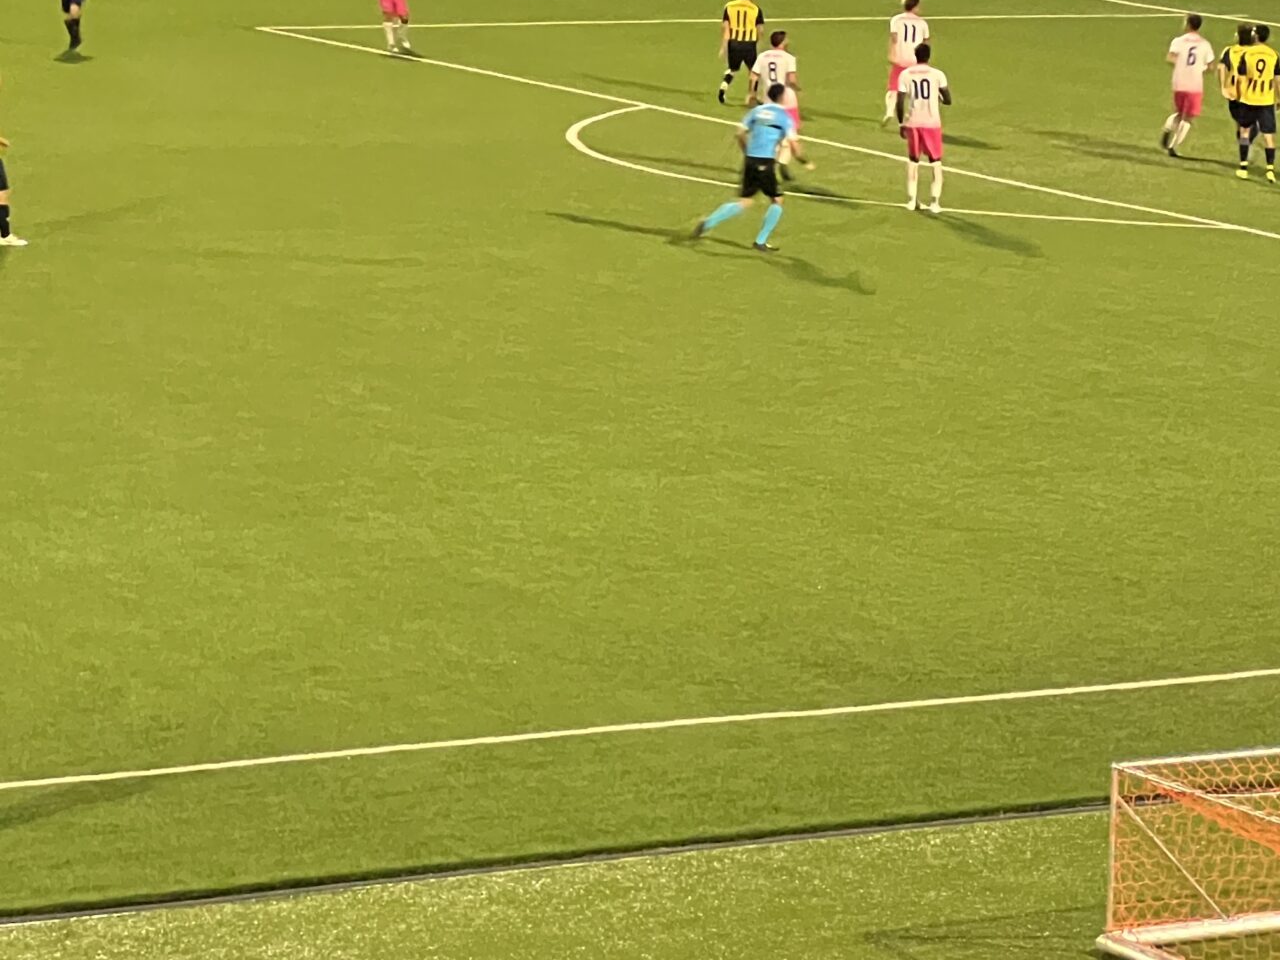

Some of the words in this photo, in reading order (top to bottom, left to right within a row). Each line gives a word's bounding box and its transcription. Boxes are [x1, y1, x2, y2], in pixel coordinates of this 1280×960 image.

[737, 10, 747, 28] 11
[904, 23, 916, 42] 11
[1187, 46, 1197, 66] 6
[768, 61, 777, 82] 8
[1256, 58, 1266, 79] 9
[911, 78, 931, 100] 10
